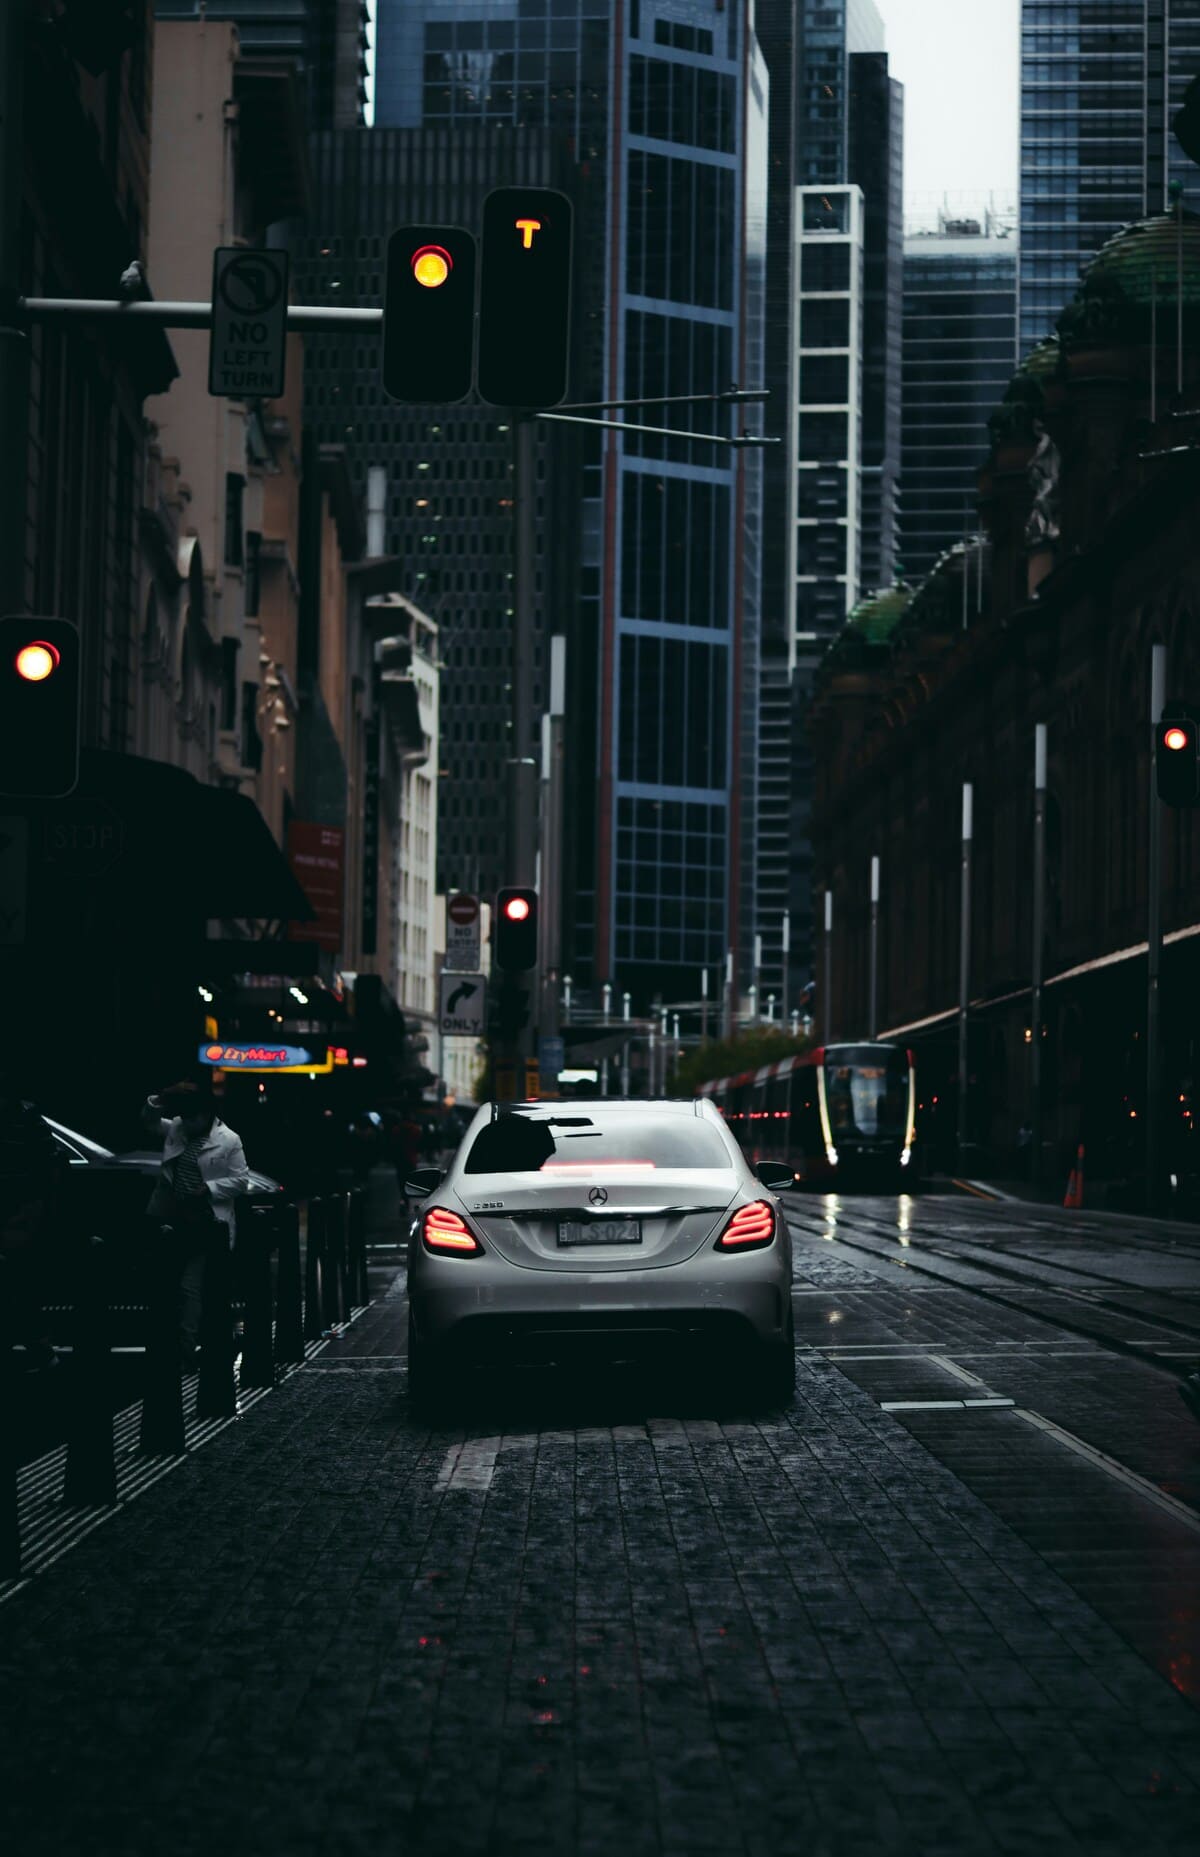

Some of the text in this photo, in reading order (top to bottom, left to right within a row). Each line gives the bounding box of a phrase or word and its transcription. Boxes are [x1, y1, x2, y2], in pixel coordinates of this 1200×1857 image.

[229, 322, 268, 344] NO
[223, 350, 272, 366] LEFT
[221, 371, 273, 387] TURN
[55, 823, 113, 849] STOP
[454, 927, 472, 937] NO
[442, 1018, 481, 1032] ONLY
[223, 1046, 287, 1063] EzyMart
